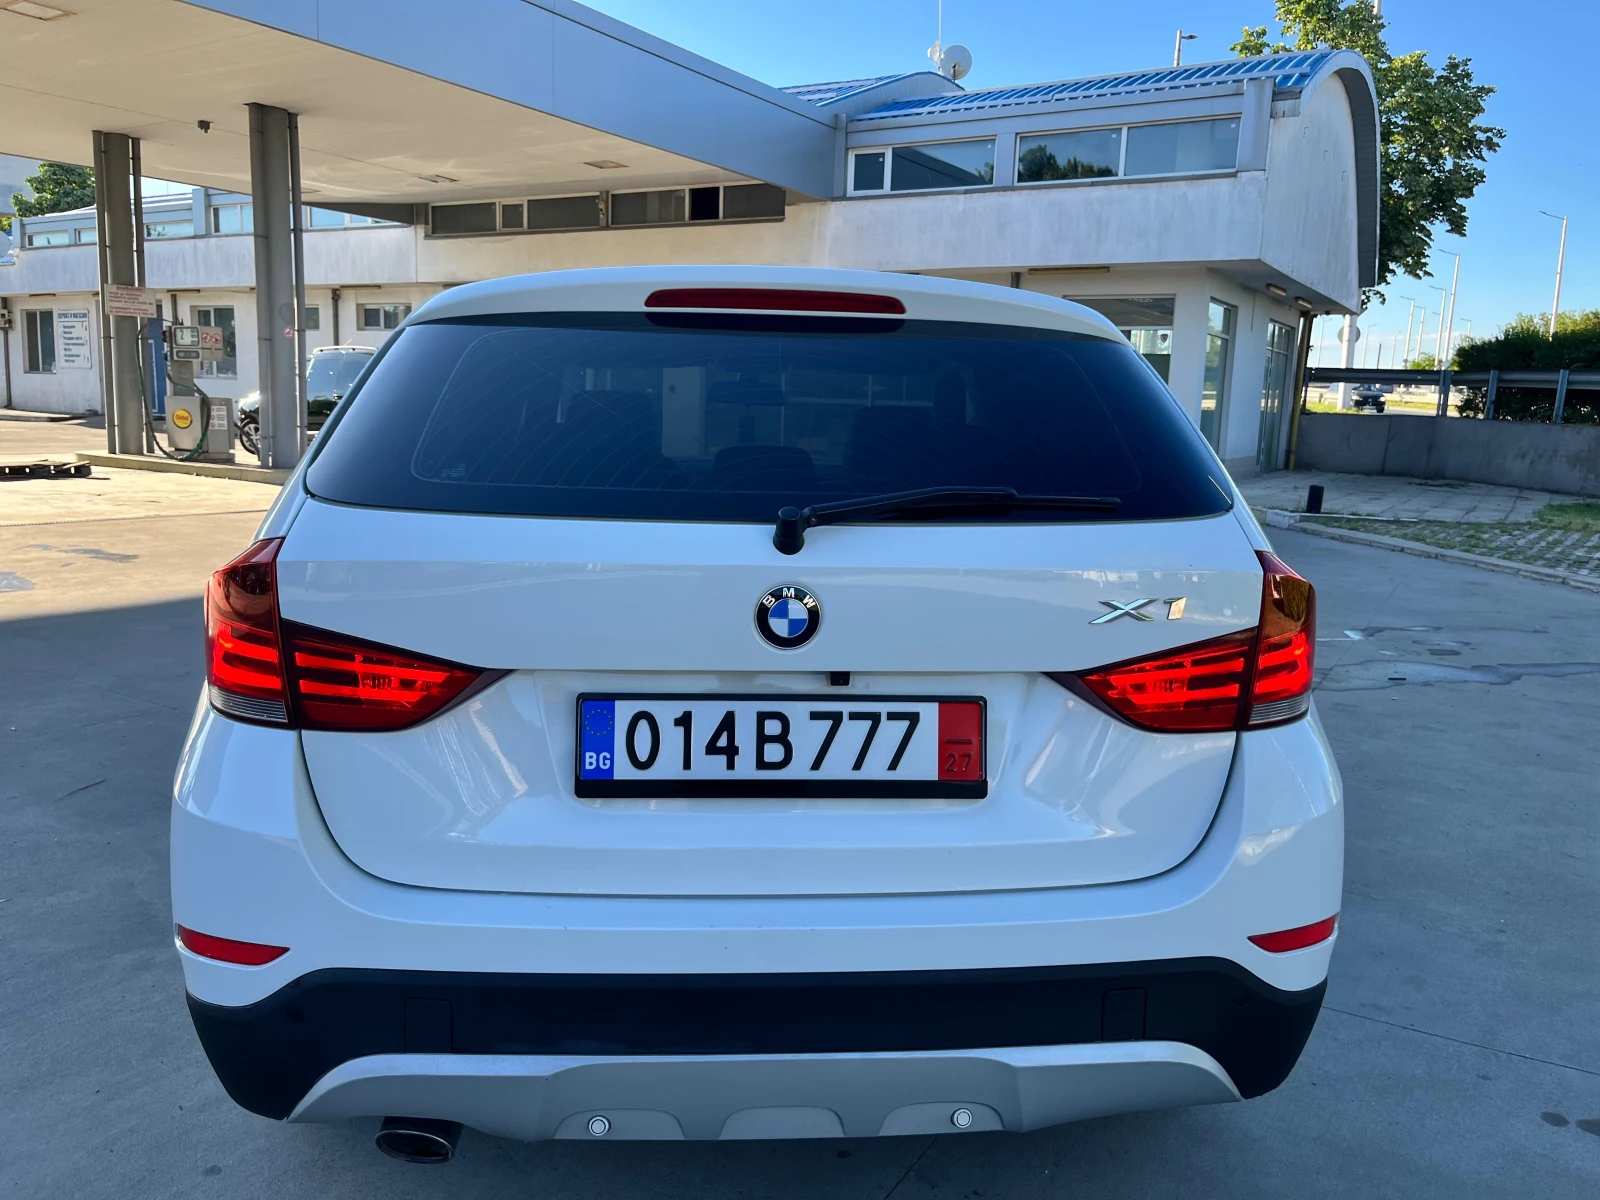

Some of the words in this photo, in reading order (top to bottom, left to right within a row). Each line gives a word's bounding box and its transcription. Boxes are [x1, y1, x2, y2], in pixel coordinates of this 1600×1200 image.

[762, 587, 816, 608] BMW
[1088, 596, 1187, 624] X1
[585, 752, 611, 770] BG
